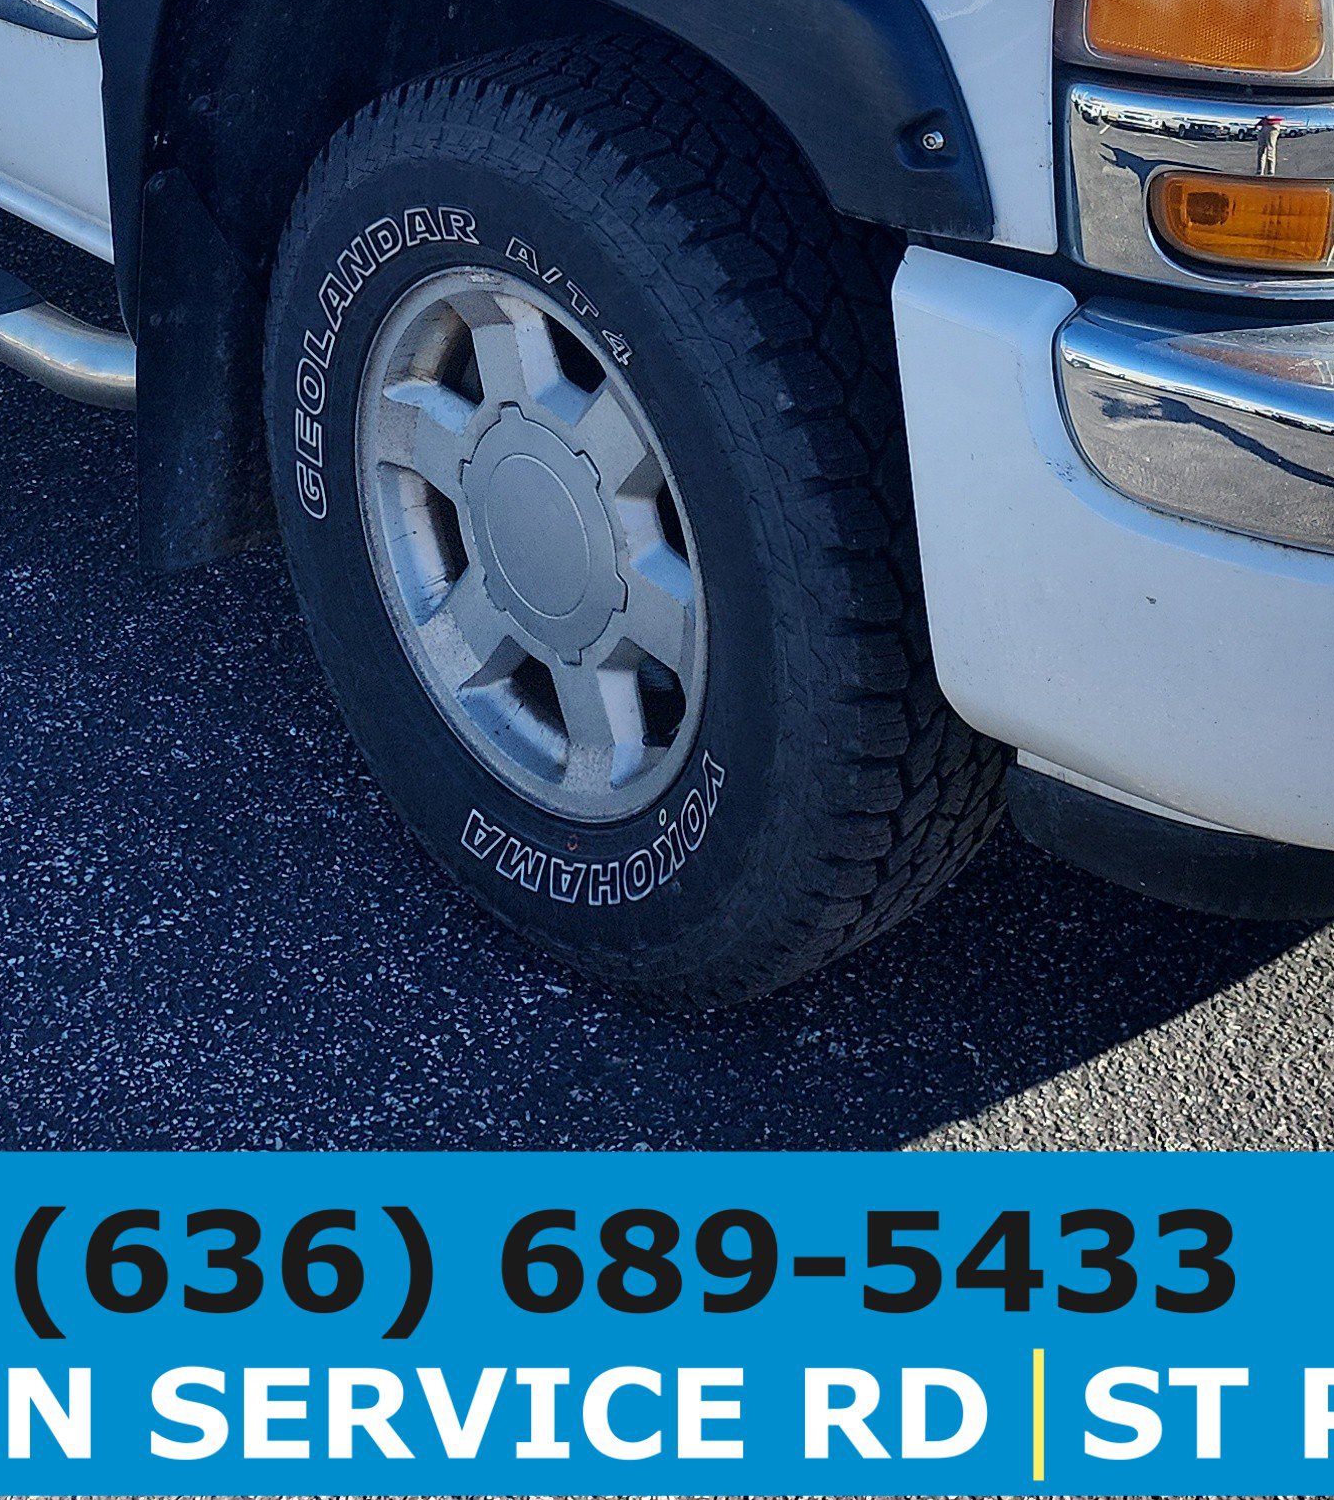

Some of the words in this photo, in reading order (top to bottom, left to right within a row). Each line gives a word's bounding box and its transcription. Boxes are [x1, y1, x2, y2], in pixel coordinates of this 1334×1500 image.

[295, 206, 480, 520] GEOLANDAR
[505, 237, 601, 320] A/T
[603, 329, 631, 367] 4
[461, 751, 725, 906] YOKOHAMA
